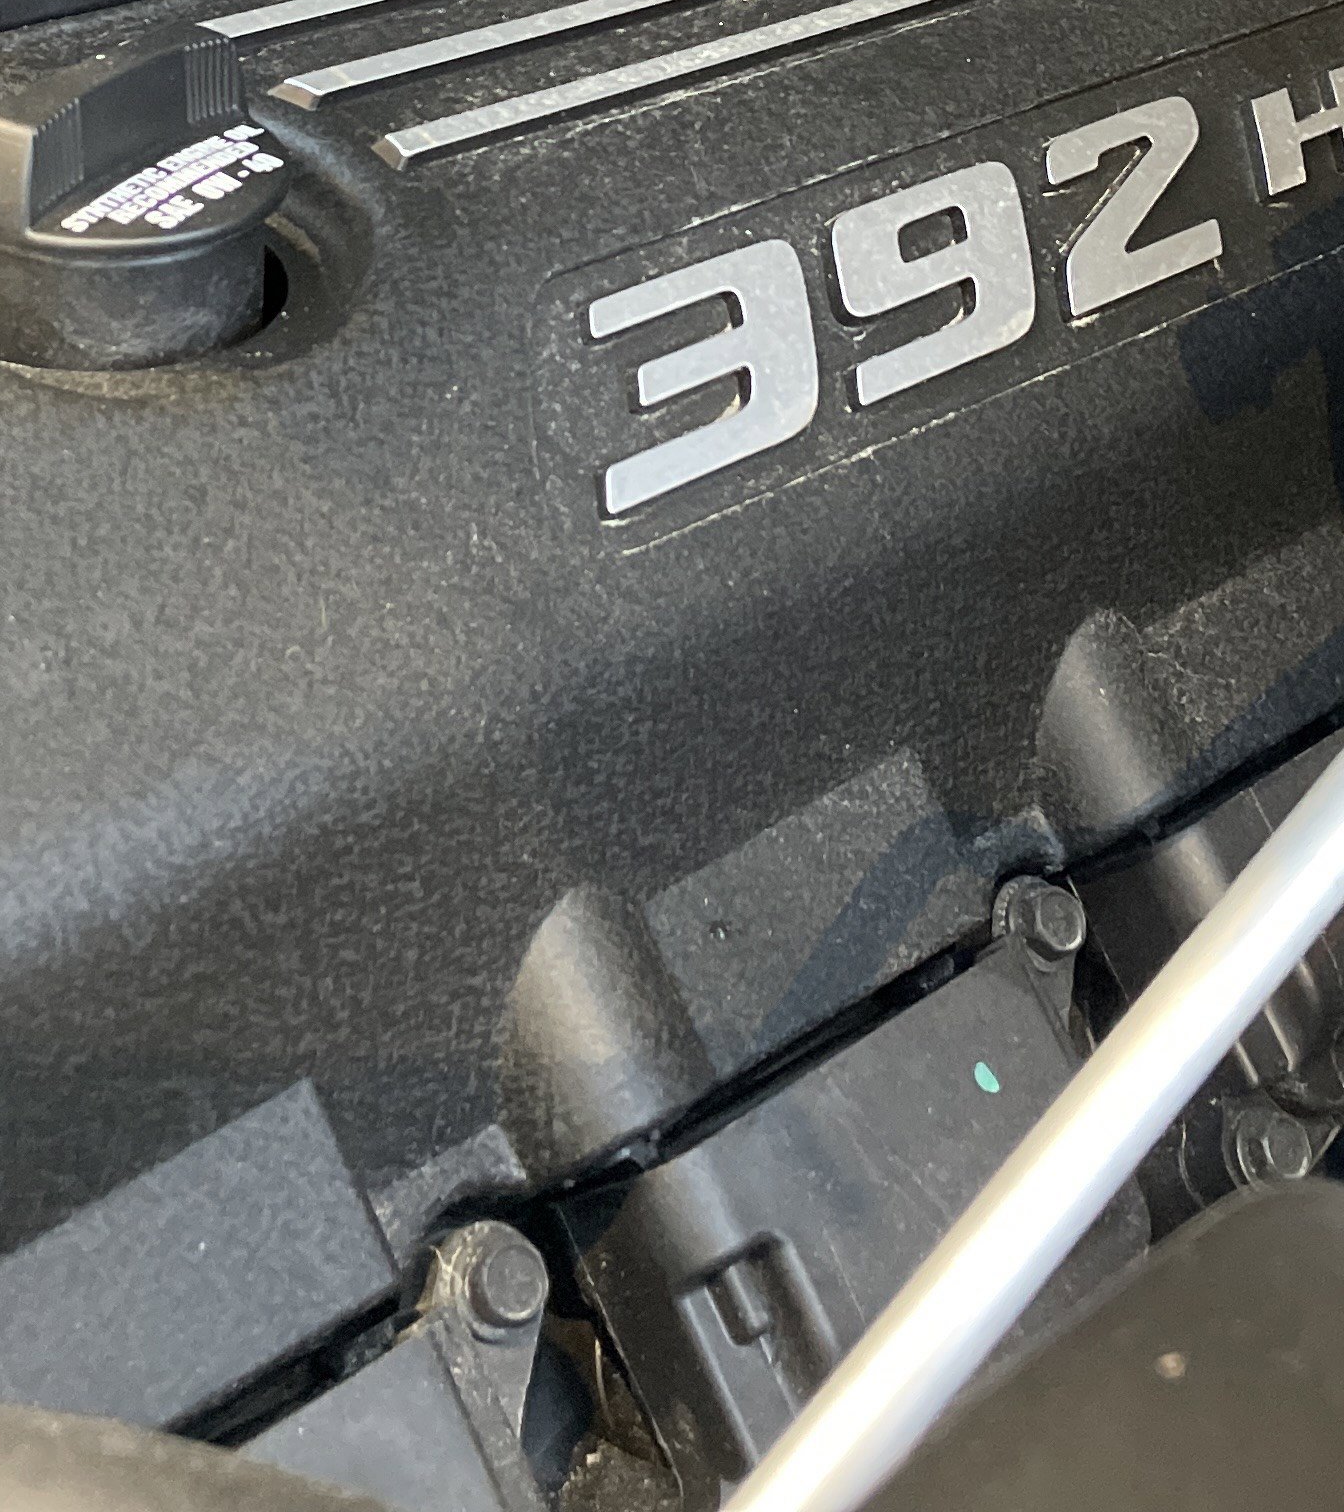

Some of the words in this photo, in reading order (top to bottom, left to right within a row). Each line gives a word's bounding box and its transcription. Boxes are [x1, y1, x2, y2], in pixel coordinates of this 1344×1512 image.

[61, 167, 167, 233] SYNTHETIC
[156, 136, 234, 172] ENGINE
[107, 141, 259, 225] RECOMMENDED
[144, 195, 204, 229] SAE
[588, 95, 1223, 514] 392
